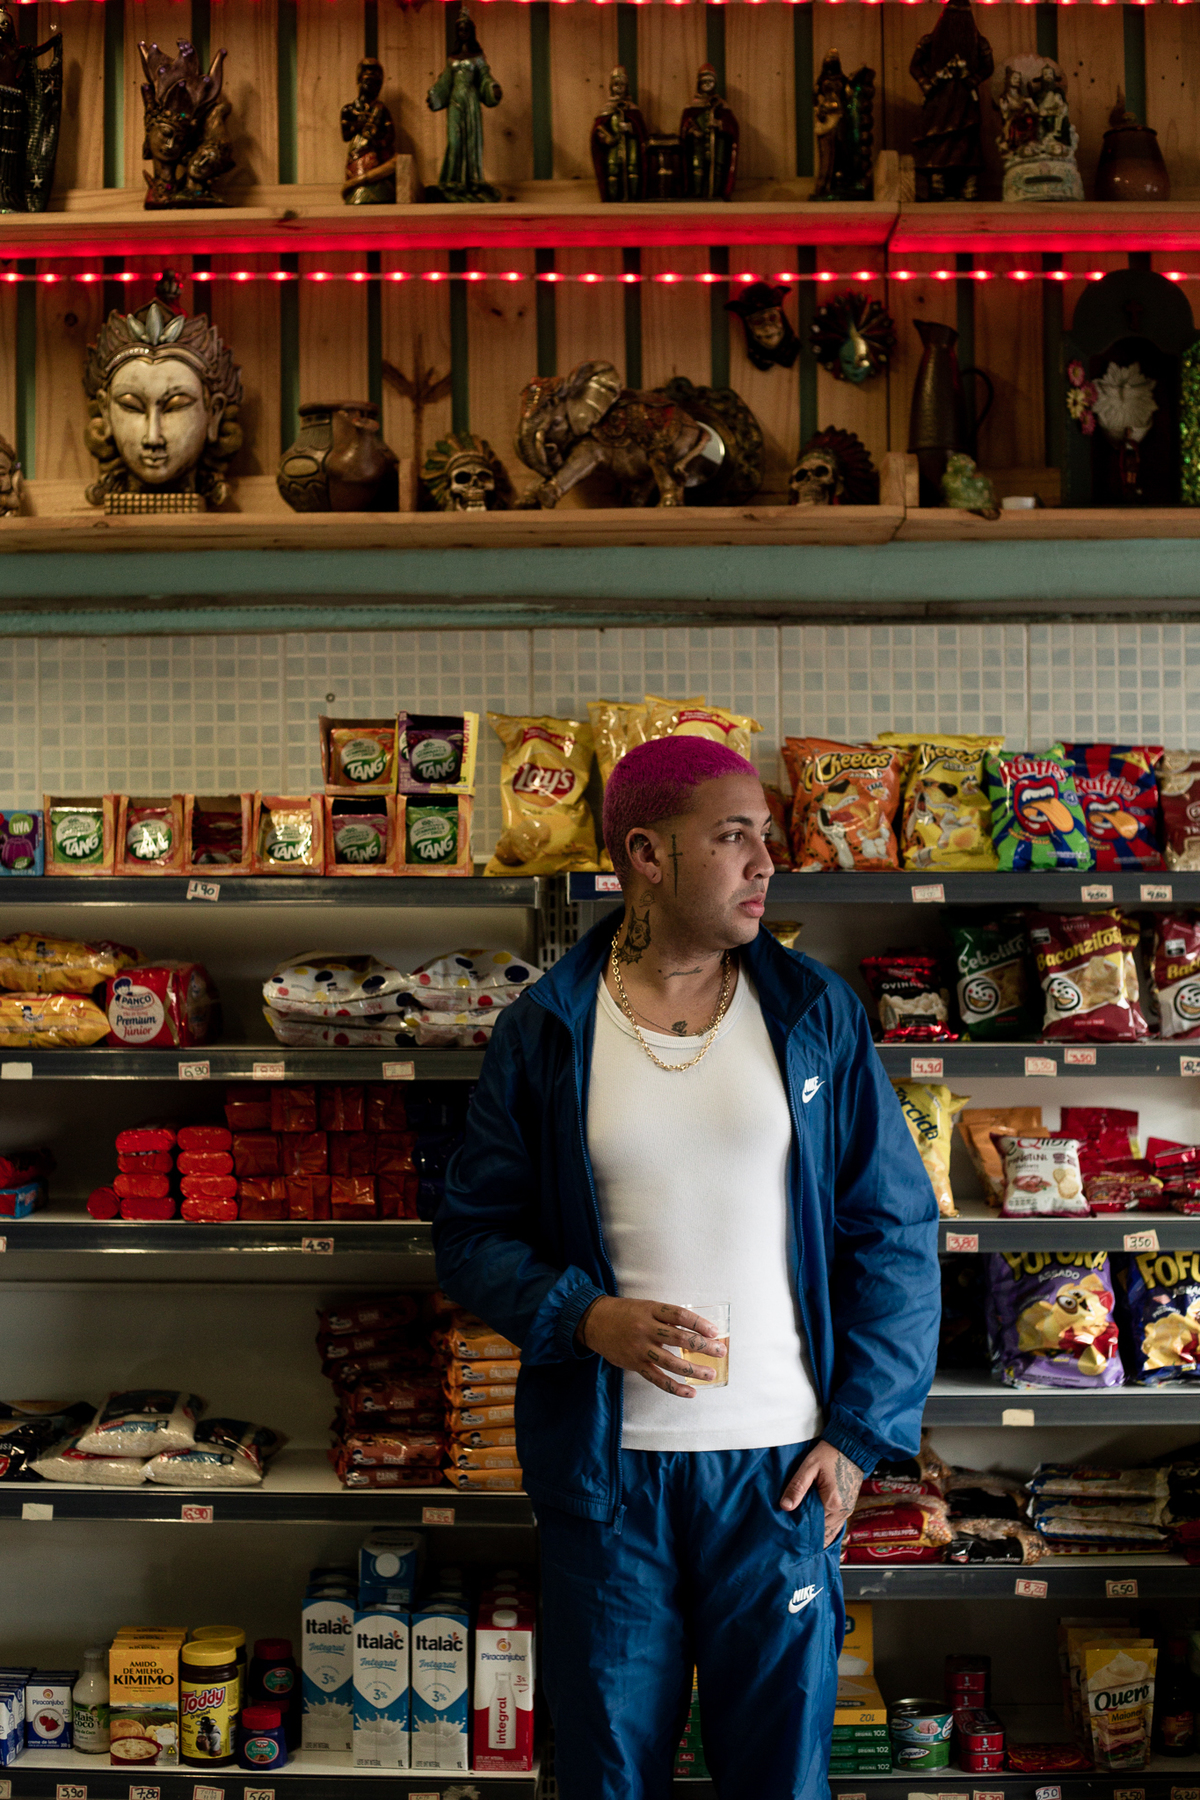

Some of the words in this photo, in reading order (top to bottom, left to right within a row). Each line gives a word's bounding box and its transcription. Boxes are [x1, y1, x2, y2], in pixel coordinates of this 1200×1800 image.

[347, 759, 383, 780] TANG
[418, 757, 456, 780] TANG
[815, 752, 894, 784] Cheetos
[1000, 755, 1068, 788] Ruffles
[515, 762, 574, 797] Lay's
[1075, 774, 1141, 801] Ruffles
[12, 821, 30, 834] UVA
[63, 835, 100, 857] TANG
[343, 843, 379, 863] TANG
[417, 836, 454, 861] TANG
[957, 933, 1031, 975] Cebolito
[121, 996, 151, 1006] PANCO
[116, 1015, 156, 1026] Premium
[124, 1025, 153, 1037] Júnior
[793, 1584, 815, 1603] NIKE
[306, 1619, 352, 1635] Italac
[309, 1642, 345, 1653] Integral
[357, 1634, 404, 1650] Italac
[416, 1635, 463, 1651] Italac
[360, 1657, 397, 1669] Integral
[419, 1659, 456, 1670] Integral
[113, 1675, 174, 1685] KIMIMO
[182, 1688, 225, 1713] Toddy
[373, 1689, 388, 1700] 3%
[432, 1690, 447, 1702] 3%
[1094, 1684, 1150, 1711] Quero
[74, 1711, 94, 1721] Mais
[496, 1697, 509, 1744] integral
[876, 1746, 889, 1754] 102
